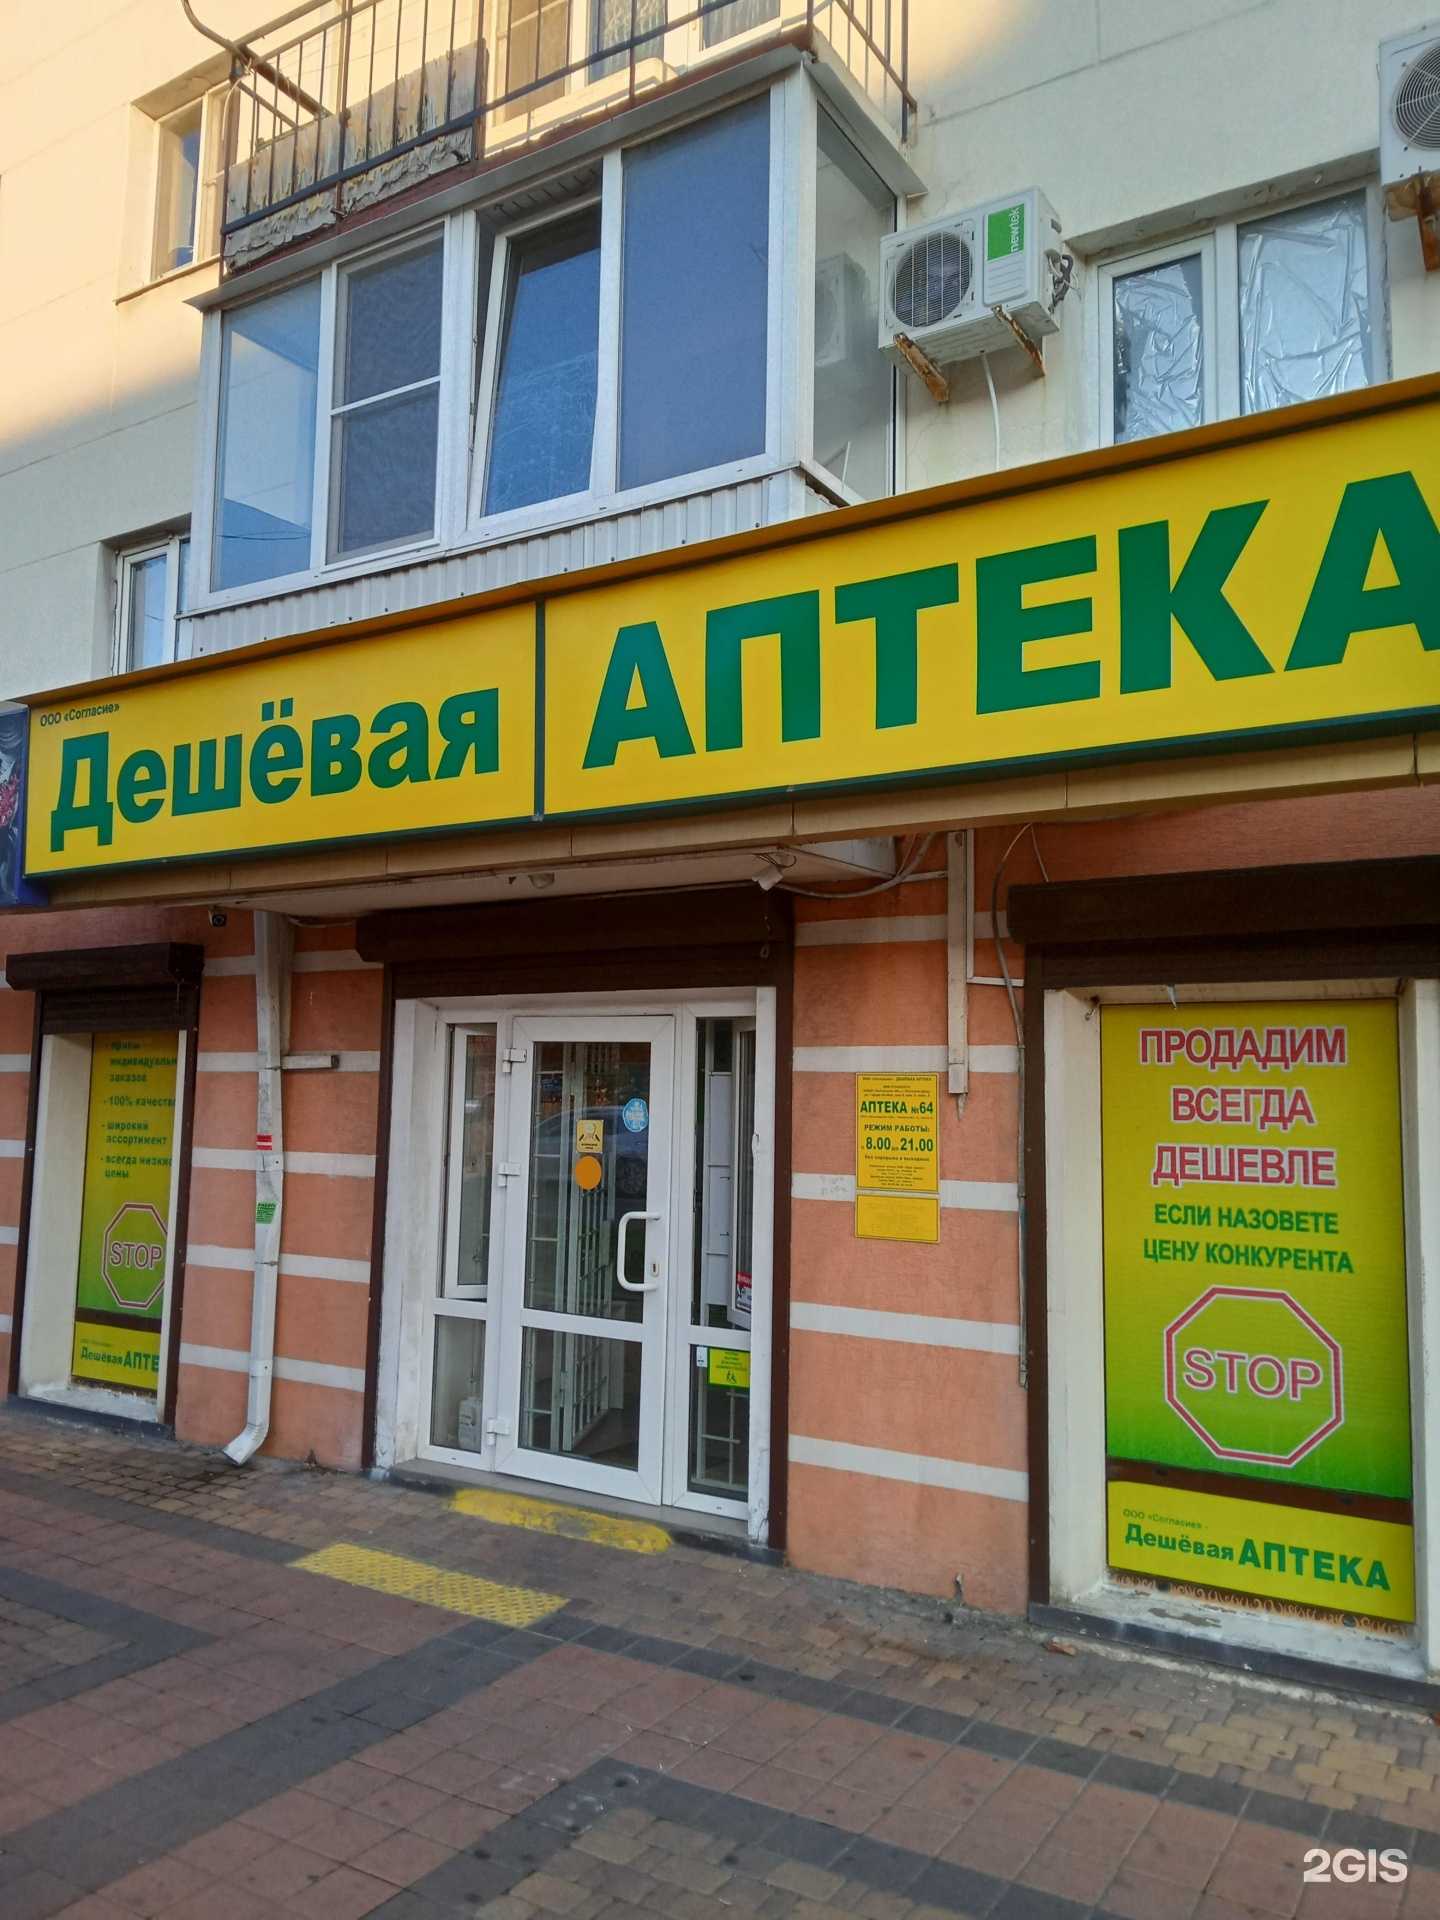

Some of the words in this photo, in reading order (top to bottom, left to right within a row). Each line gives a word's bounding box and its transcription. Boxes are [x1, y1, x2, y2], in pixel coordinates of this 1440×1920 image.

[582, 470, 1440, 769] АПТЕКА
[40, 711, 62, 727] ООО
[64, 703, 120, 722] «Согласие»
[50, 687, 500, 852] Дешёвая
[1139, 1027, 1347, 1071] ПРОДАДИМ
[860, 1100, 907, 1114] АПТЕКА
[1171, 1087, 1316, 1131] ВСЕГДА
[864, 1123, 893, 1132] РЕЖИМ
[866, 1136, 891, 1150] 8.00
[900, 1137, 934, 1152] 21.00
[1152, 1144, 1337, 1187] ДЕШЕВЛЕ
[1154, 1203, 1212, 1227] ЕСЛИ
[1217, 1207, 1339, 1235] НАЗОВЕТЕ
[110, 1241, 163, 1270] STOP
[1143, 1238, 1200, 1263] ЦЕНУ
[1205, 1242, 1355, 1274] КОНКУРЕНТА
[1184, 1349, 1323, 1400] STOP
[1124, 1523, 1235, 1561] Дешёвая
[1238, 1539, 1391, 1592] АПТЕКА
